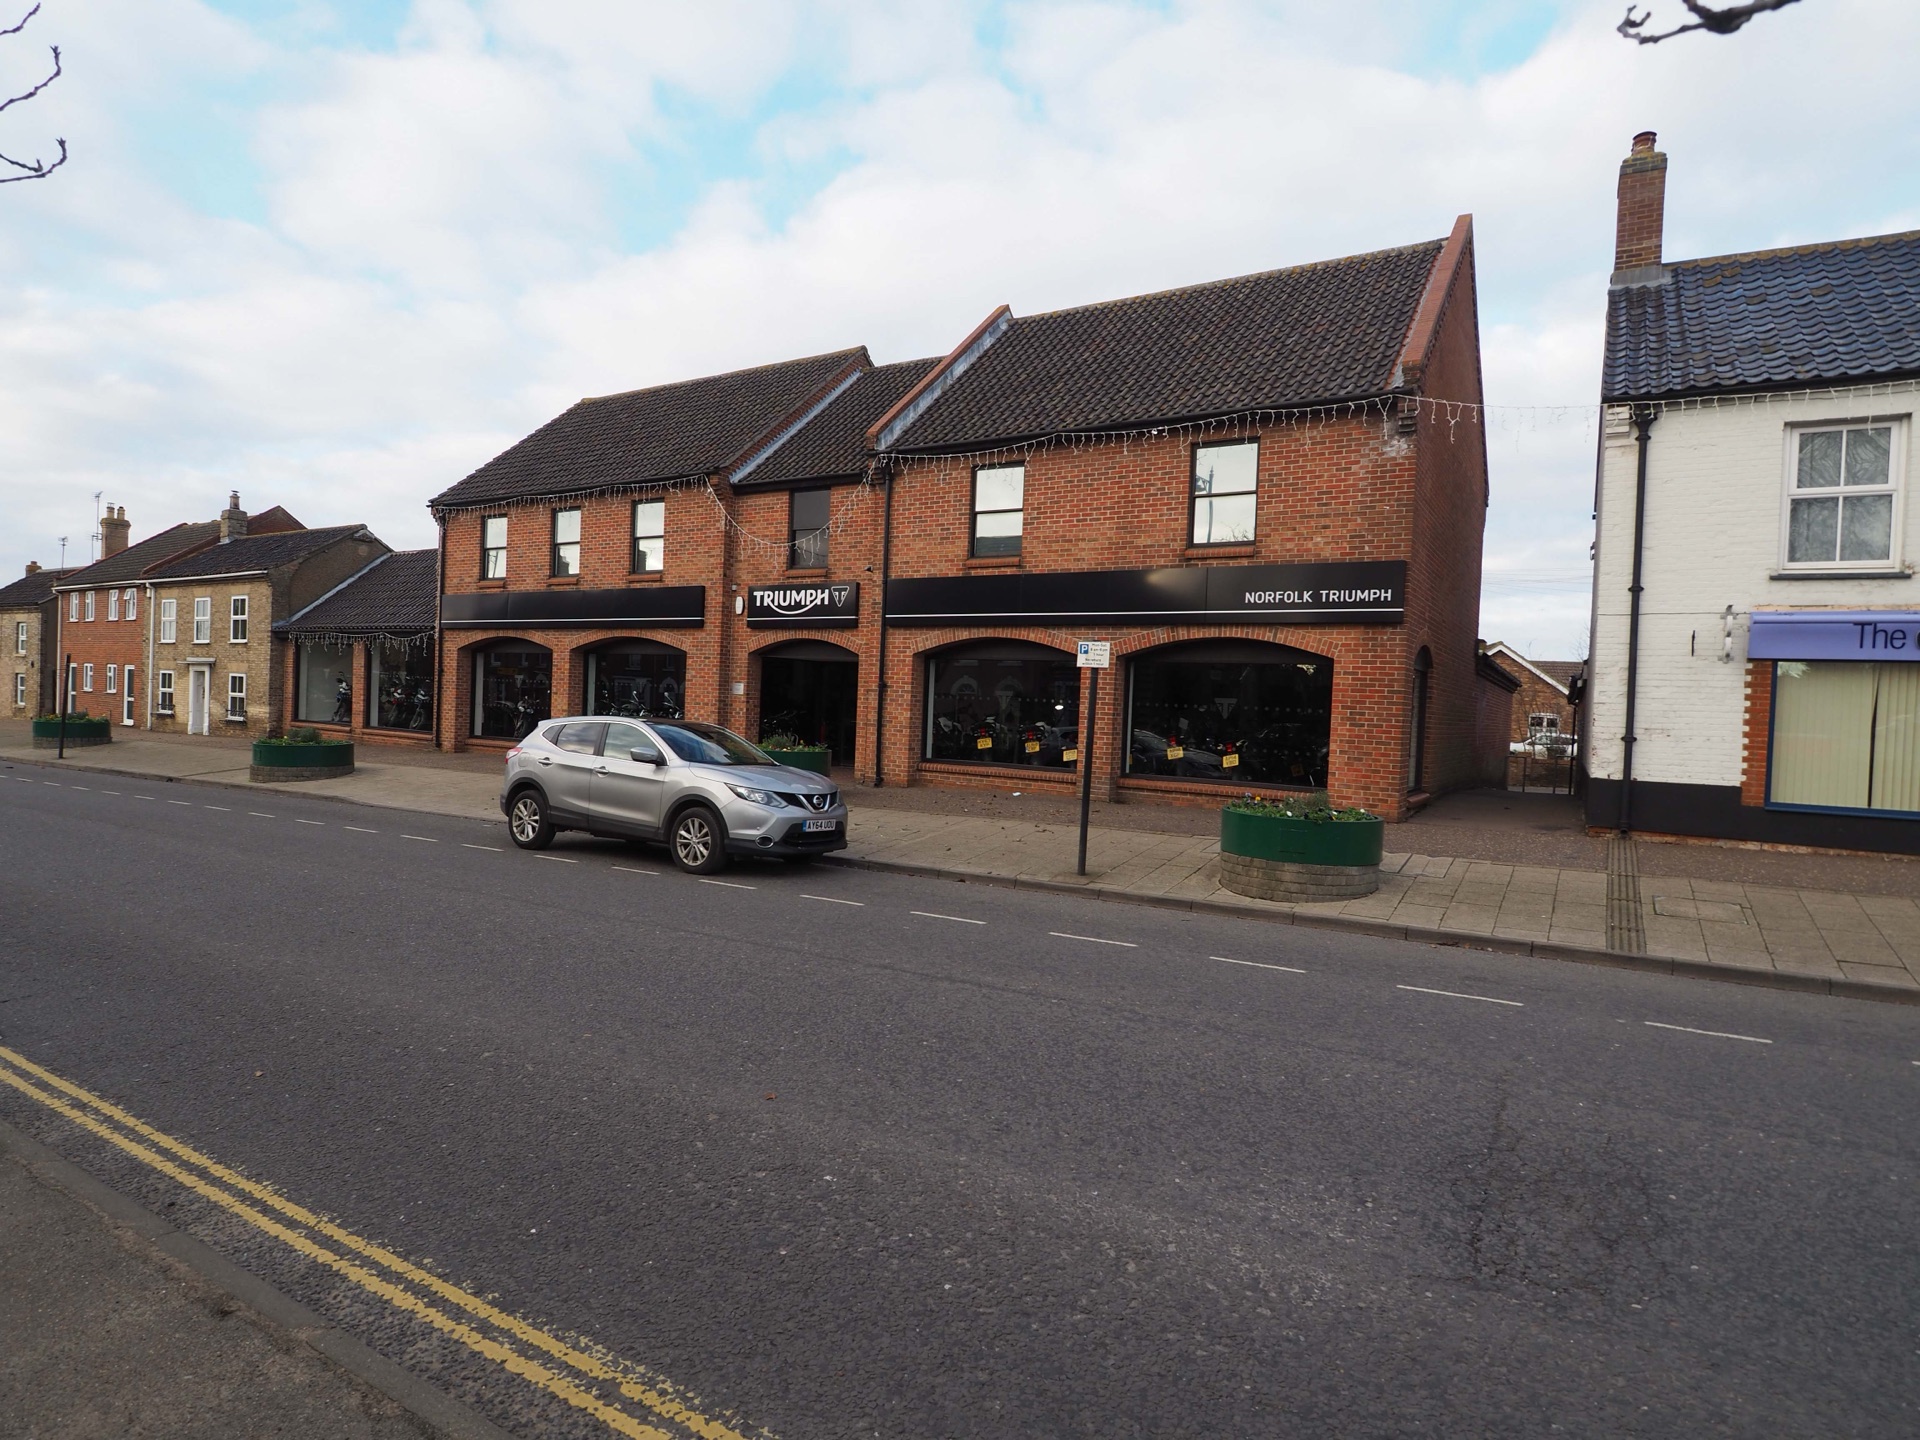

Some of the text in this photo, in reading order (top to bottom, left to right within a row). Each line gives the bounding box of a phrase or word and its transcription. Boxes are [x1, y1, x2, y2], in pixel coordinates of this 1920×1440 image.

[753, 589, 829, 614] TRIUMPH
[1245, 589, 1392, 604] NORFOLK TRIUMPH
[1852, 622, 1907, 650] The
[1081, 644, 1088, 654] P
[806, 821, 823, 830] AY64
